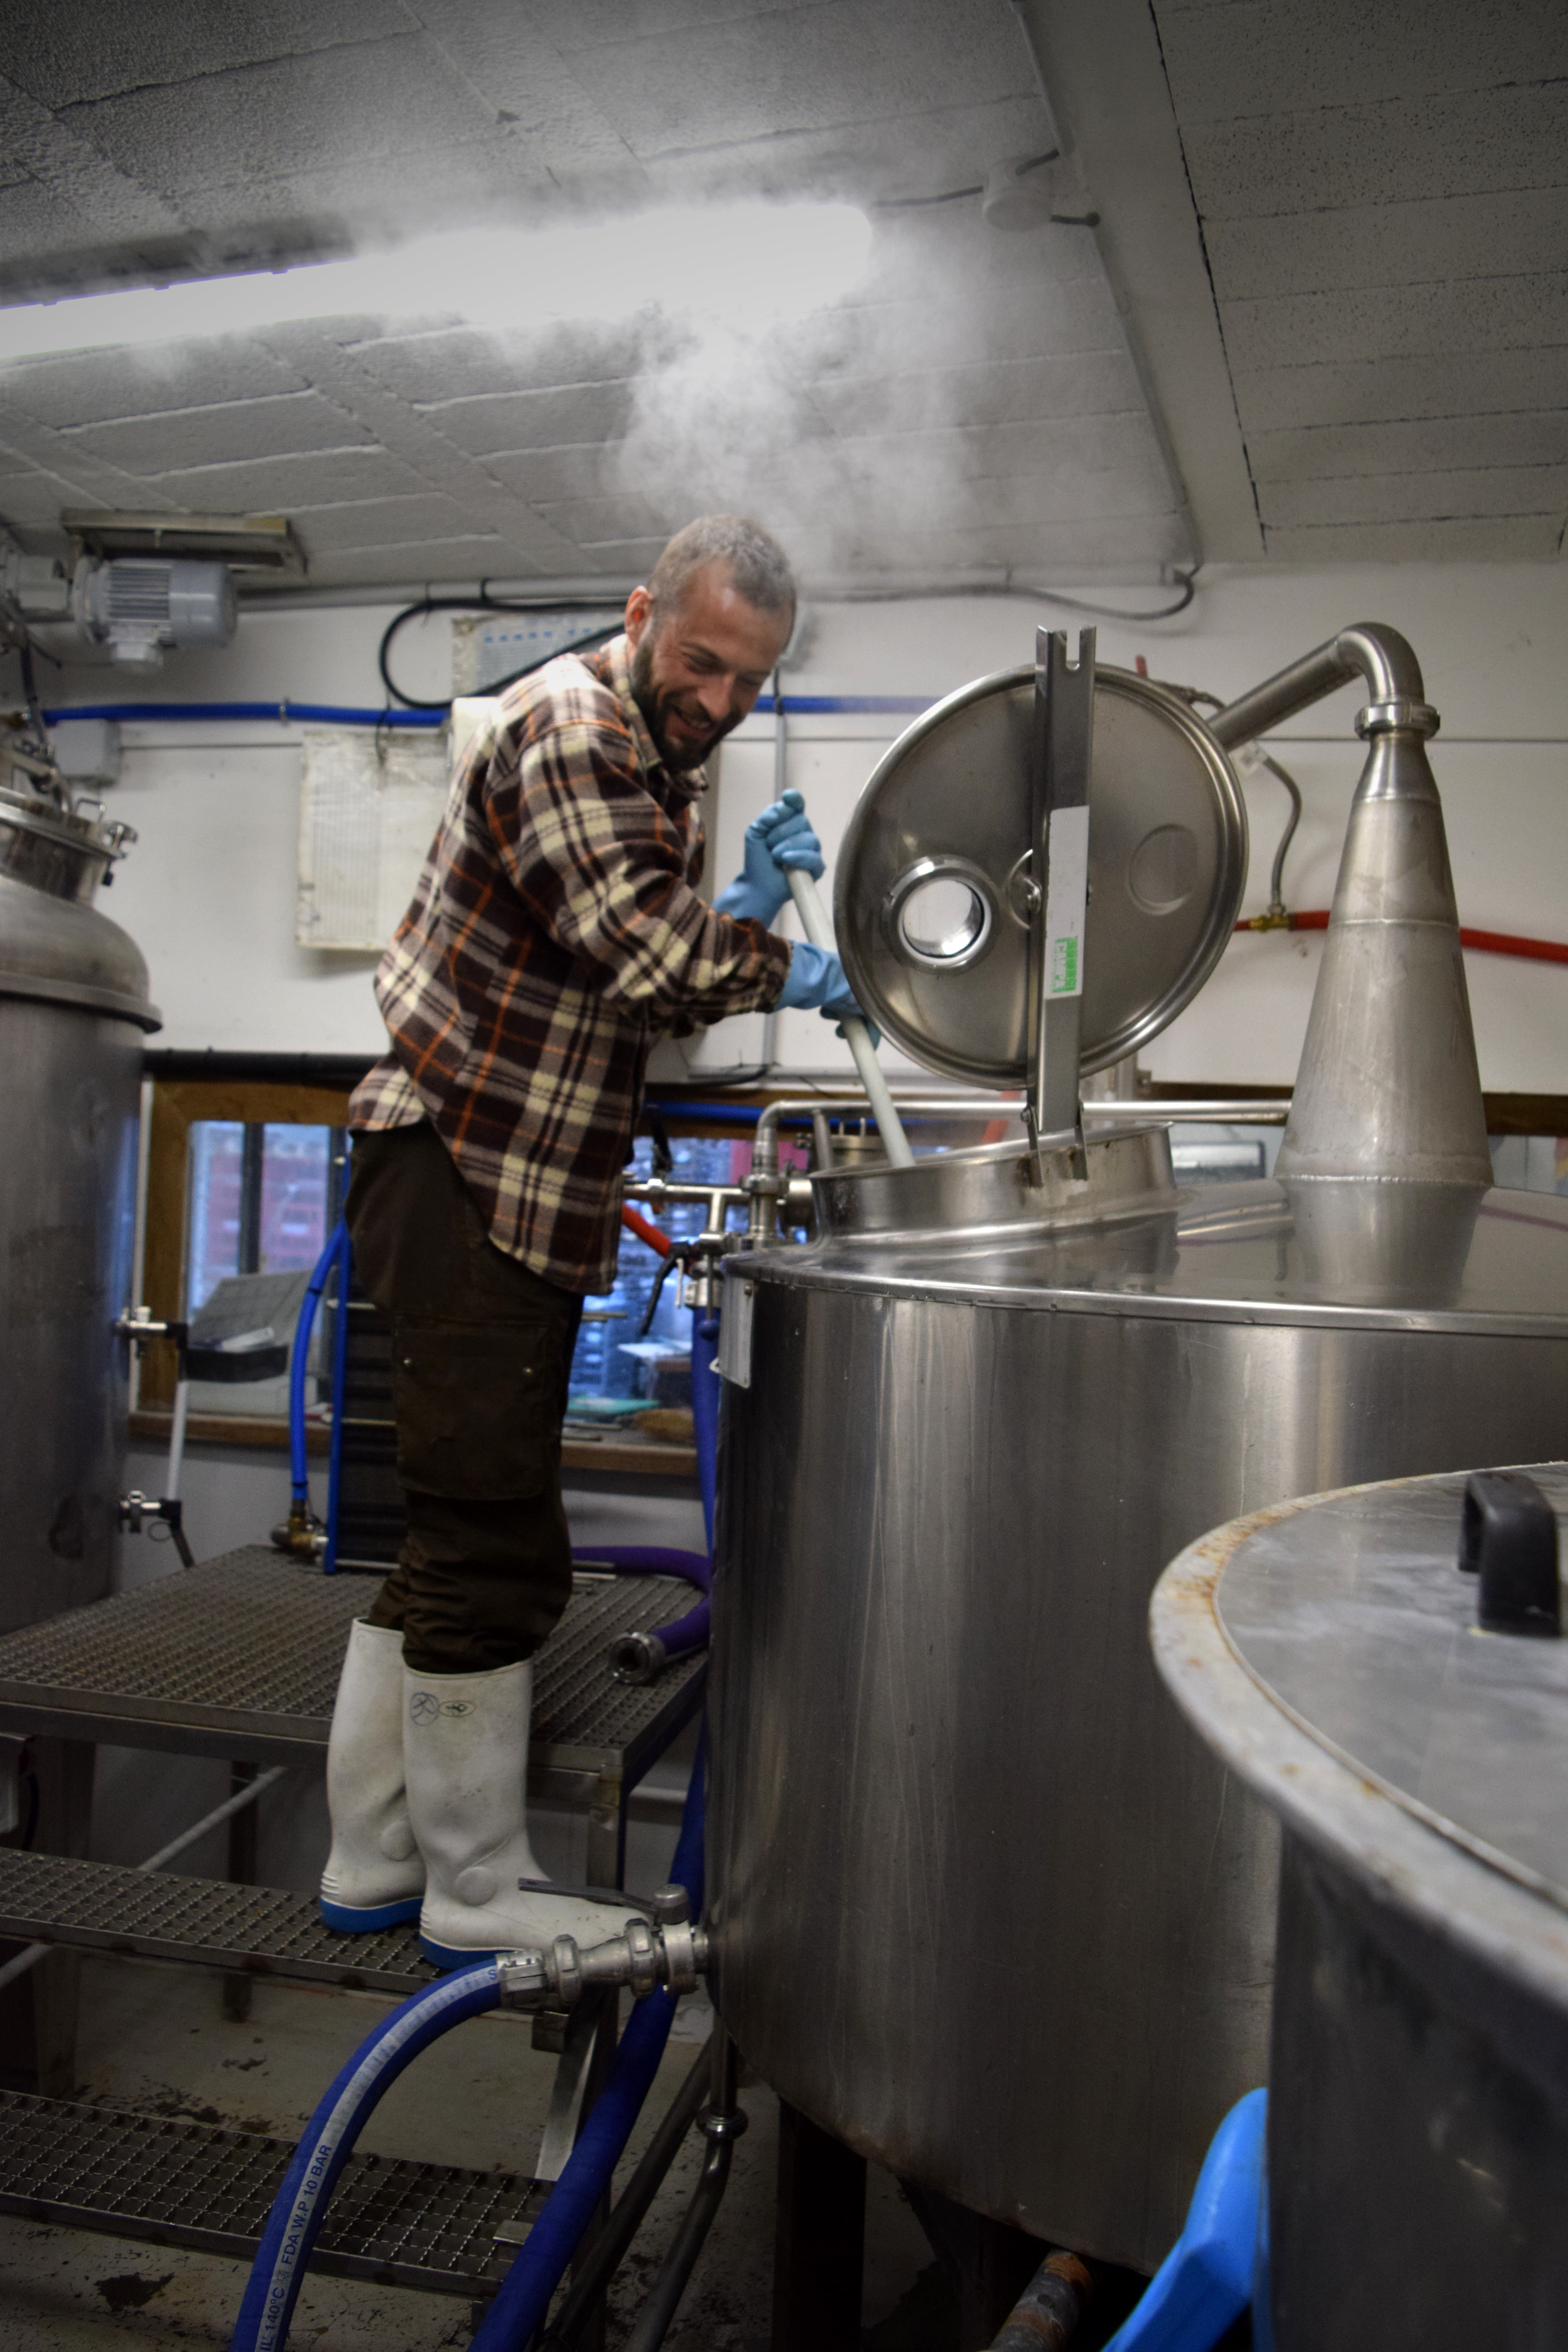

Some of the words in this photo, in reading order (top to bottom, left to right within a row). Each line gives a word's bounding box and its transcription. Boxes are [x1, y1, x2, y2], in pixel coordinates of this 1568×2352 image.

[310, 2145, 332, 2176] BAR
[303, 2180, 318, 2195] 10
[291, 2201, 309, 2227] W.P
[281, 2234, 300, 2265] FDA
